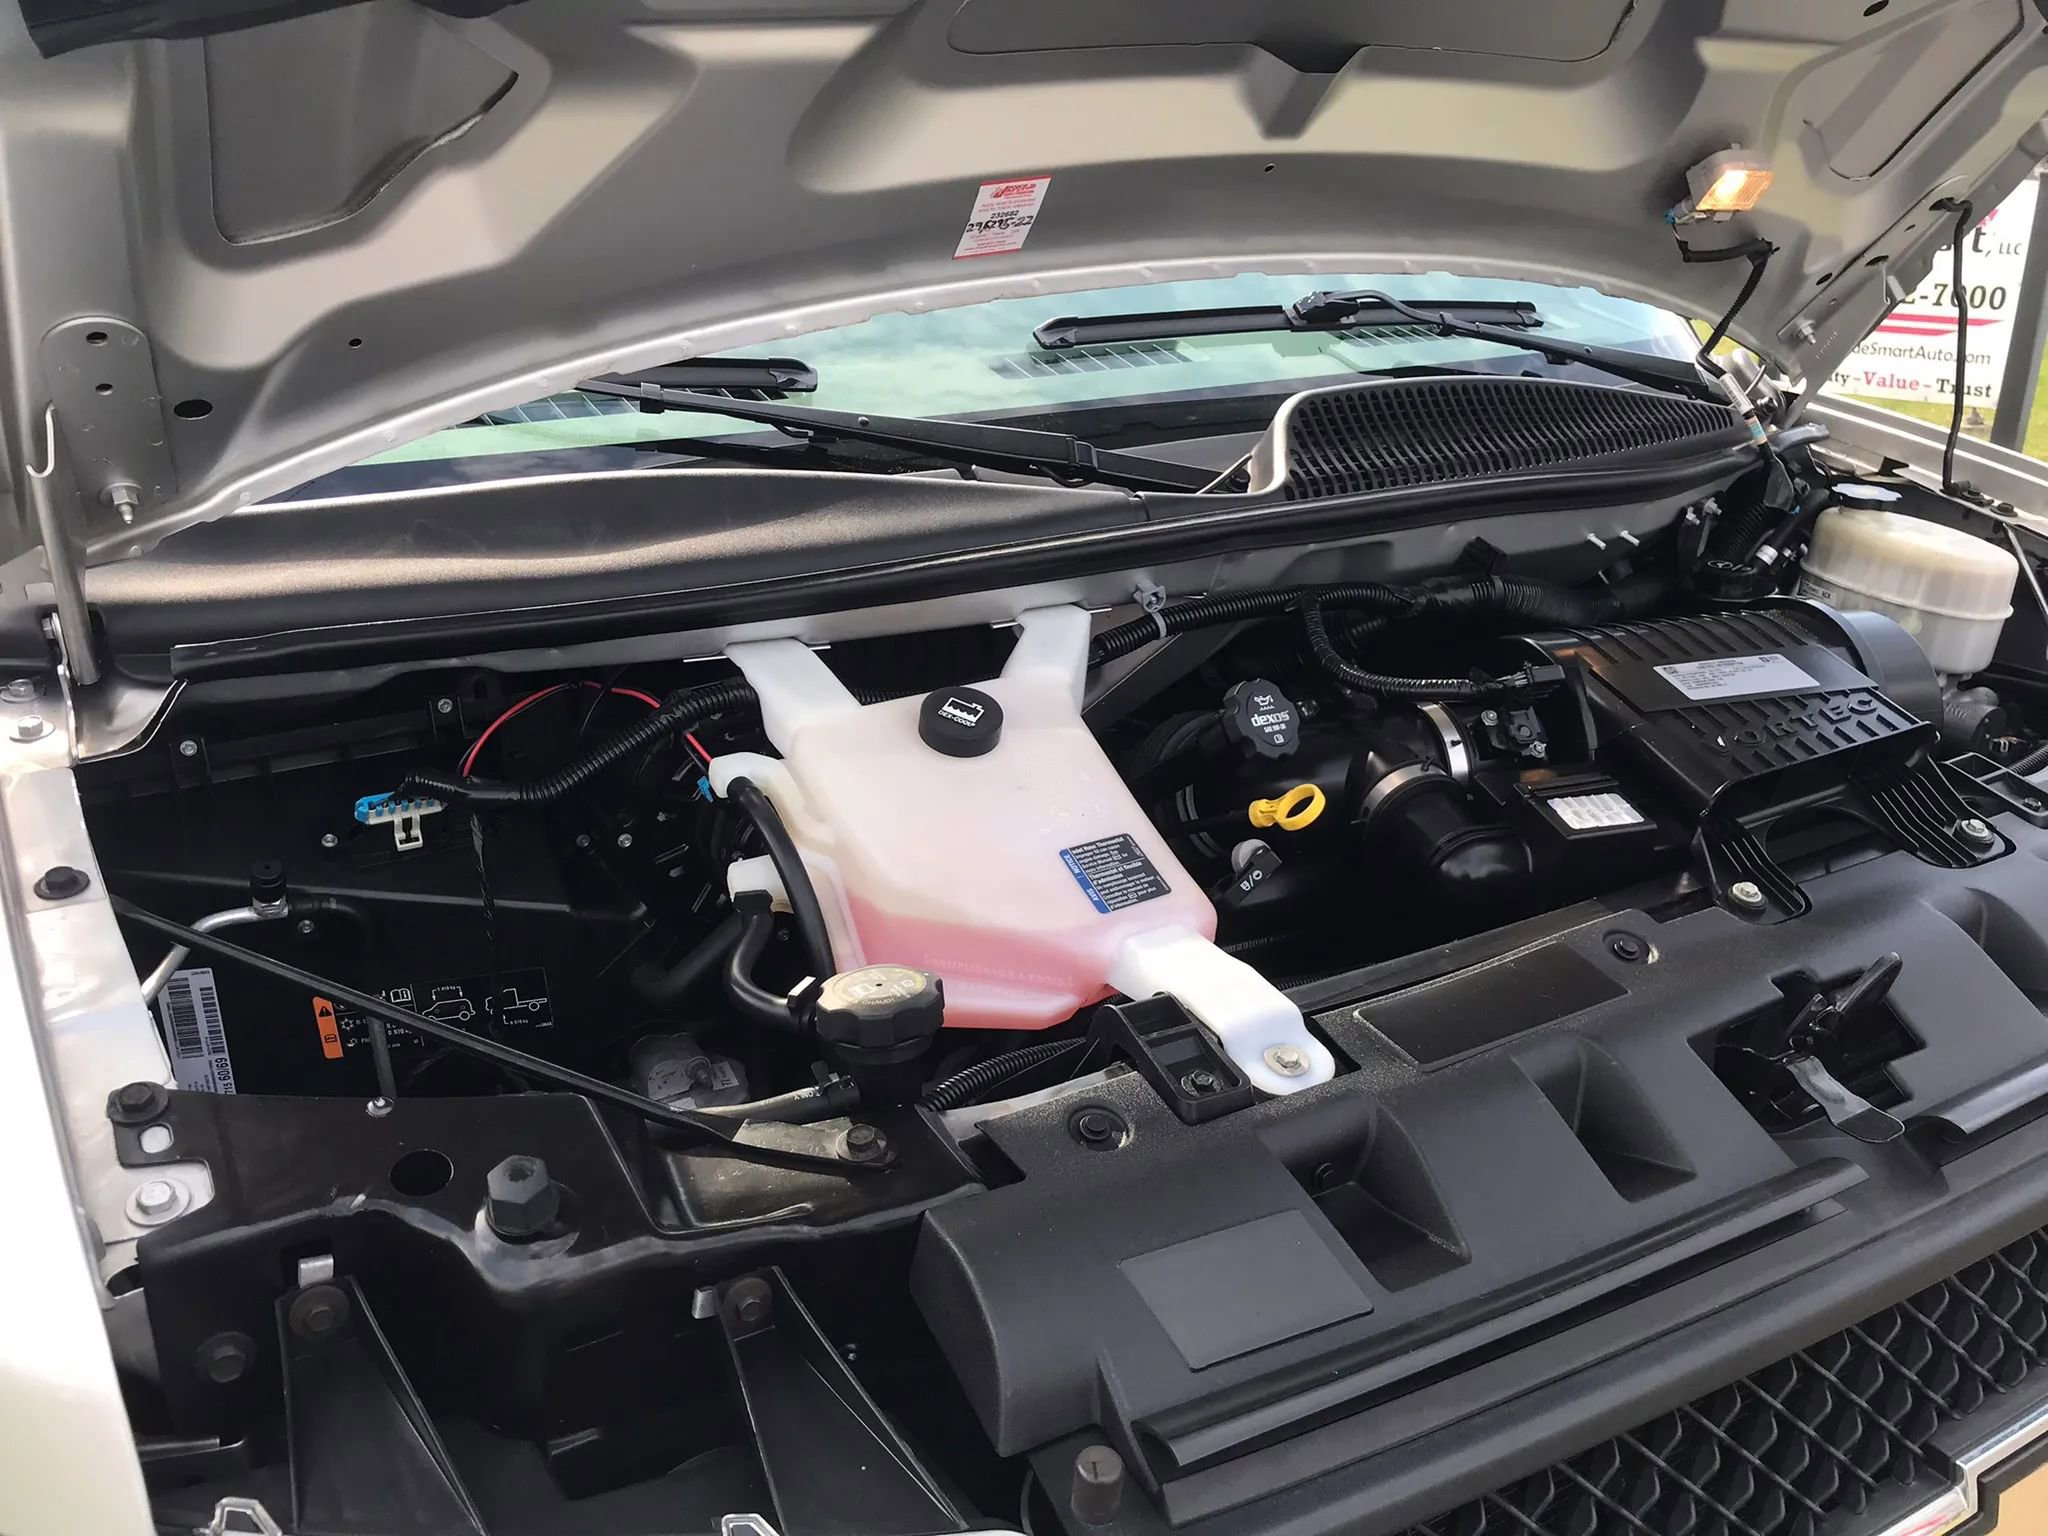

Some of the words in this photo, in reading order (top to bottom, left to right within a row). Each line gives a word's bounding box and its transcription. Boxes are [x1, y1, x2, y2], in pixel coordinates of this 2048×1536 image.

[1999, 242, 2022, 255] LLC
[1863, 371, 1919, 391] Value
[1250, 710, 1290, 727] dexos
